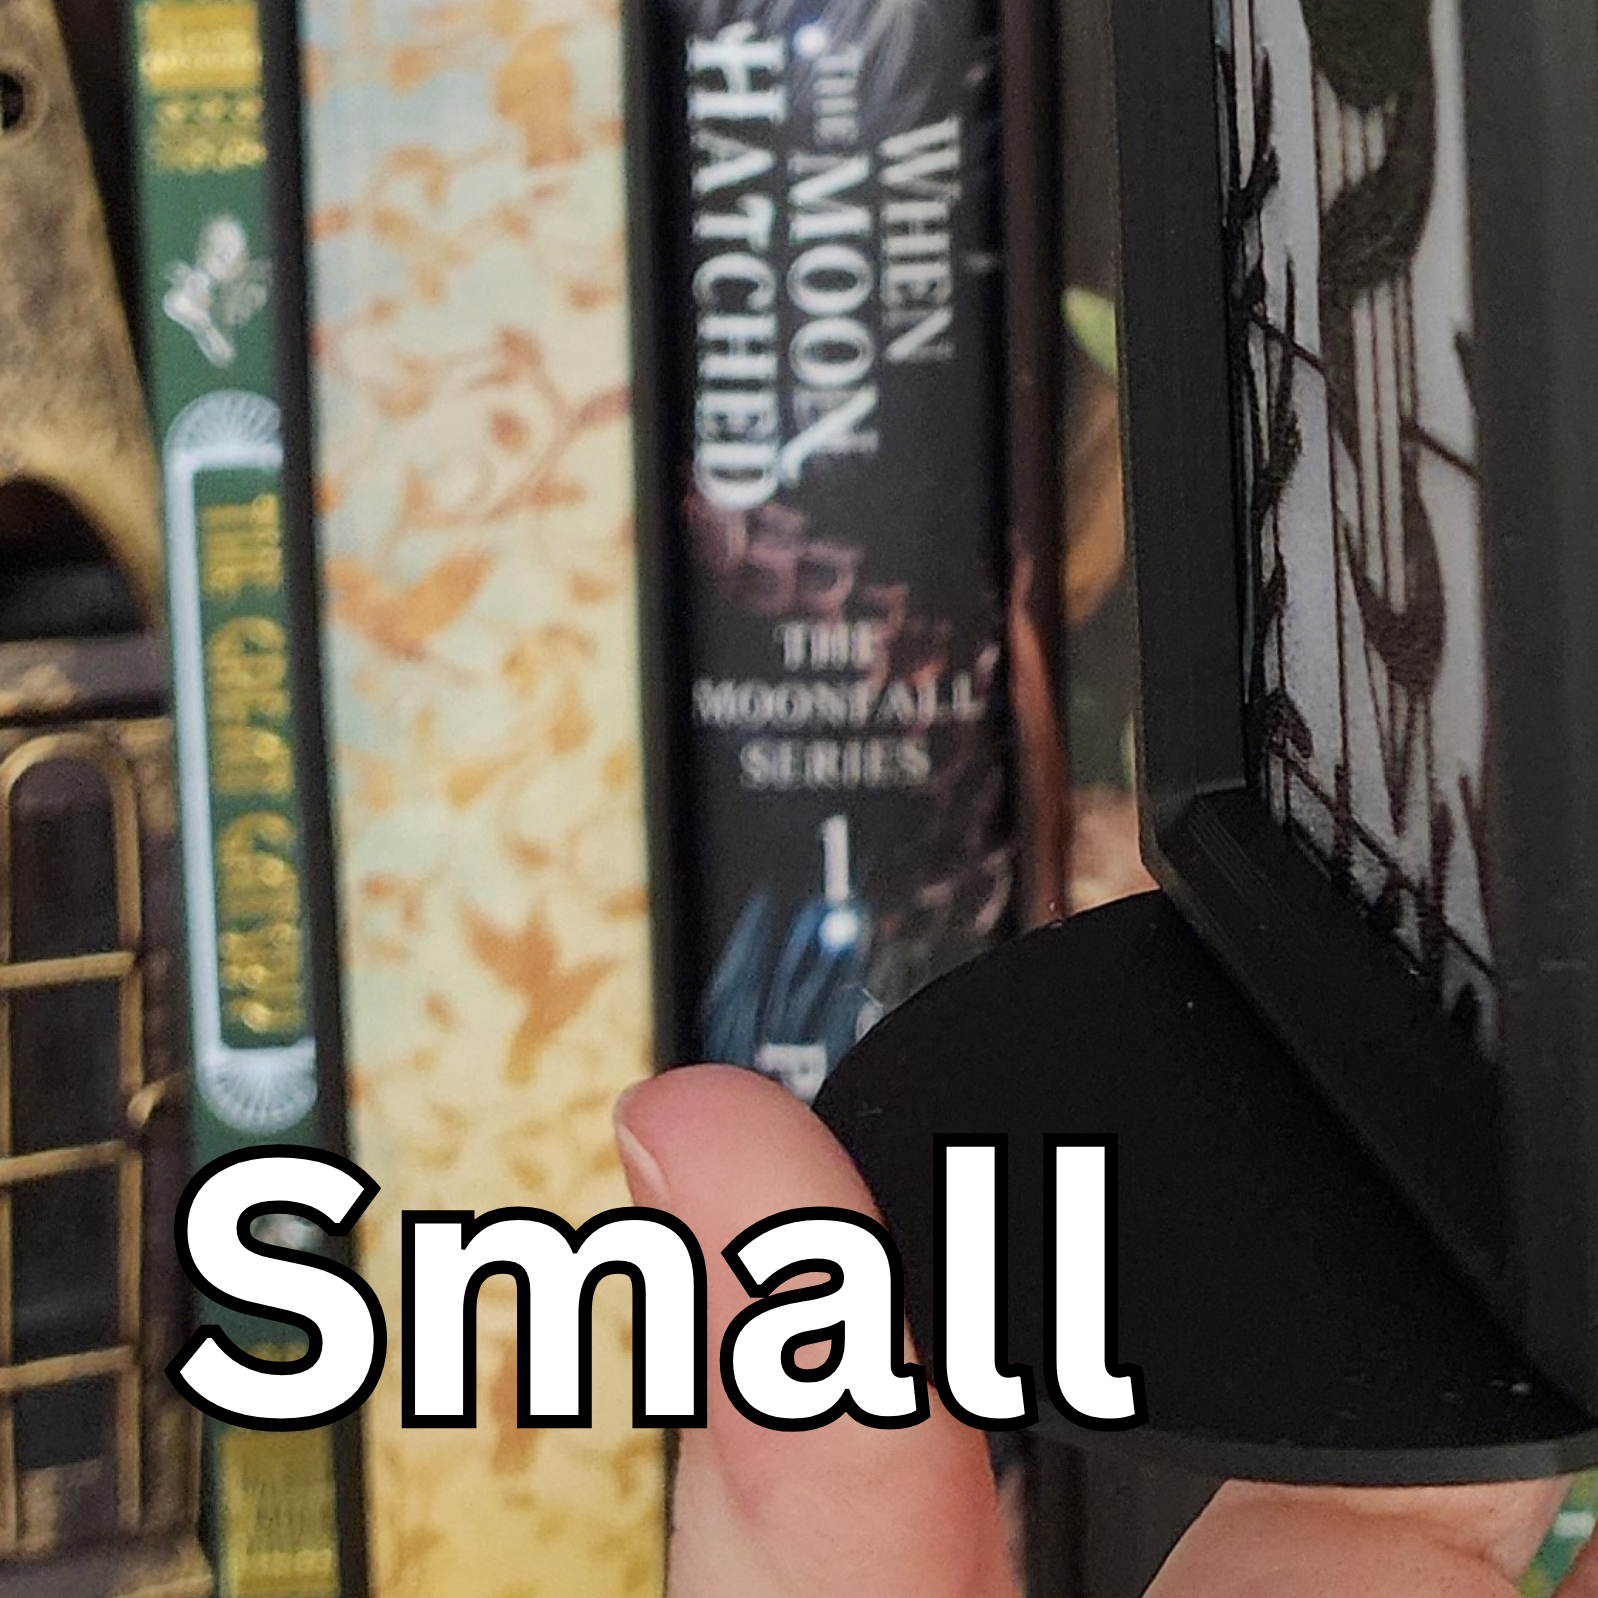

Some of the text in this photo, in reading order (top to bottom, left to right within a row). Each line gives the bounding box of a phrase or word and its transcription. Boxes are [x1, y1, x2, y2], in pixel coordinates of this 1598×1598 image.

[686, 19, 787, 509] HATCHED
[780, 153, 880, 489] MOON
[877, 115, 962, 363] WHEN
